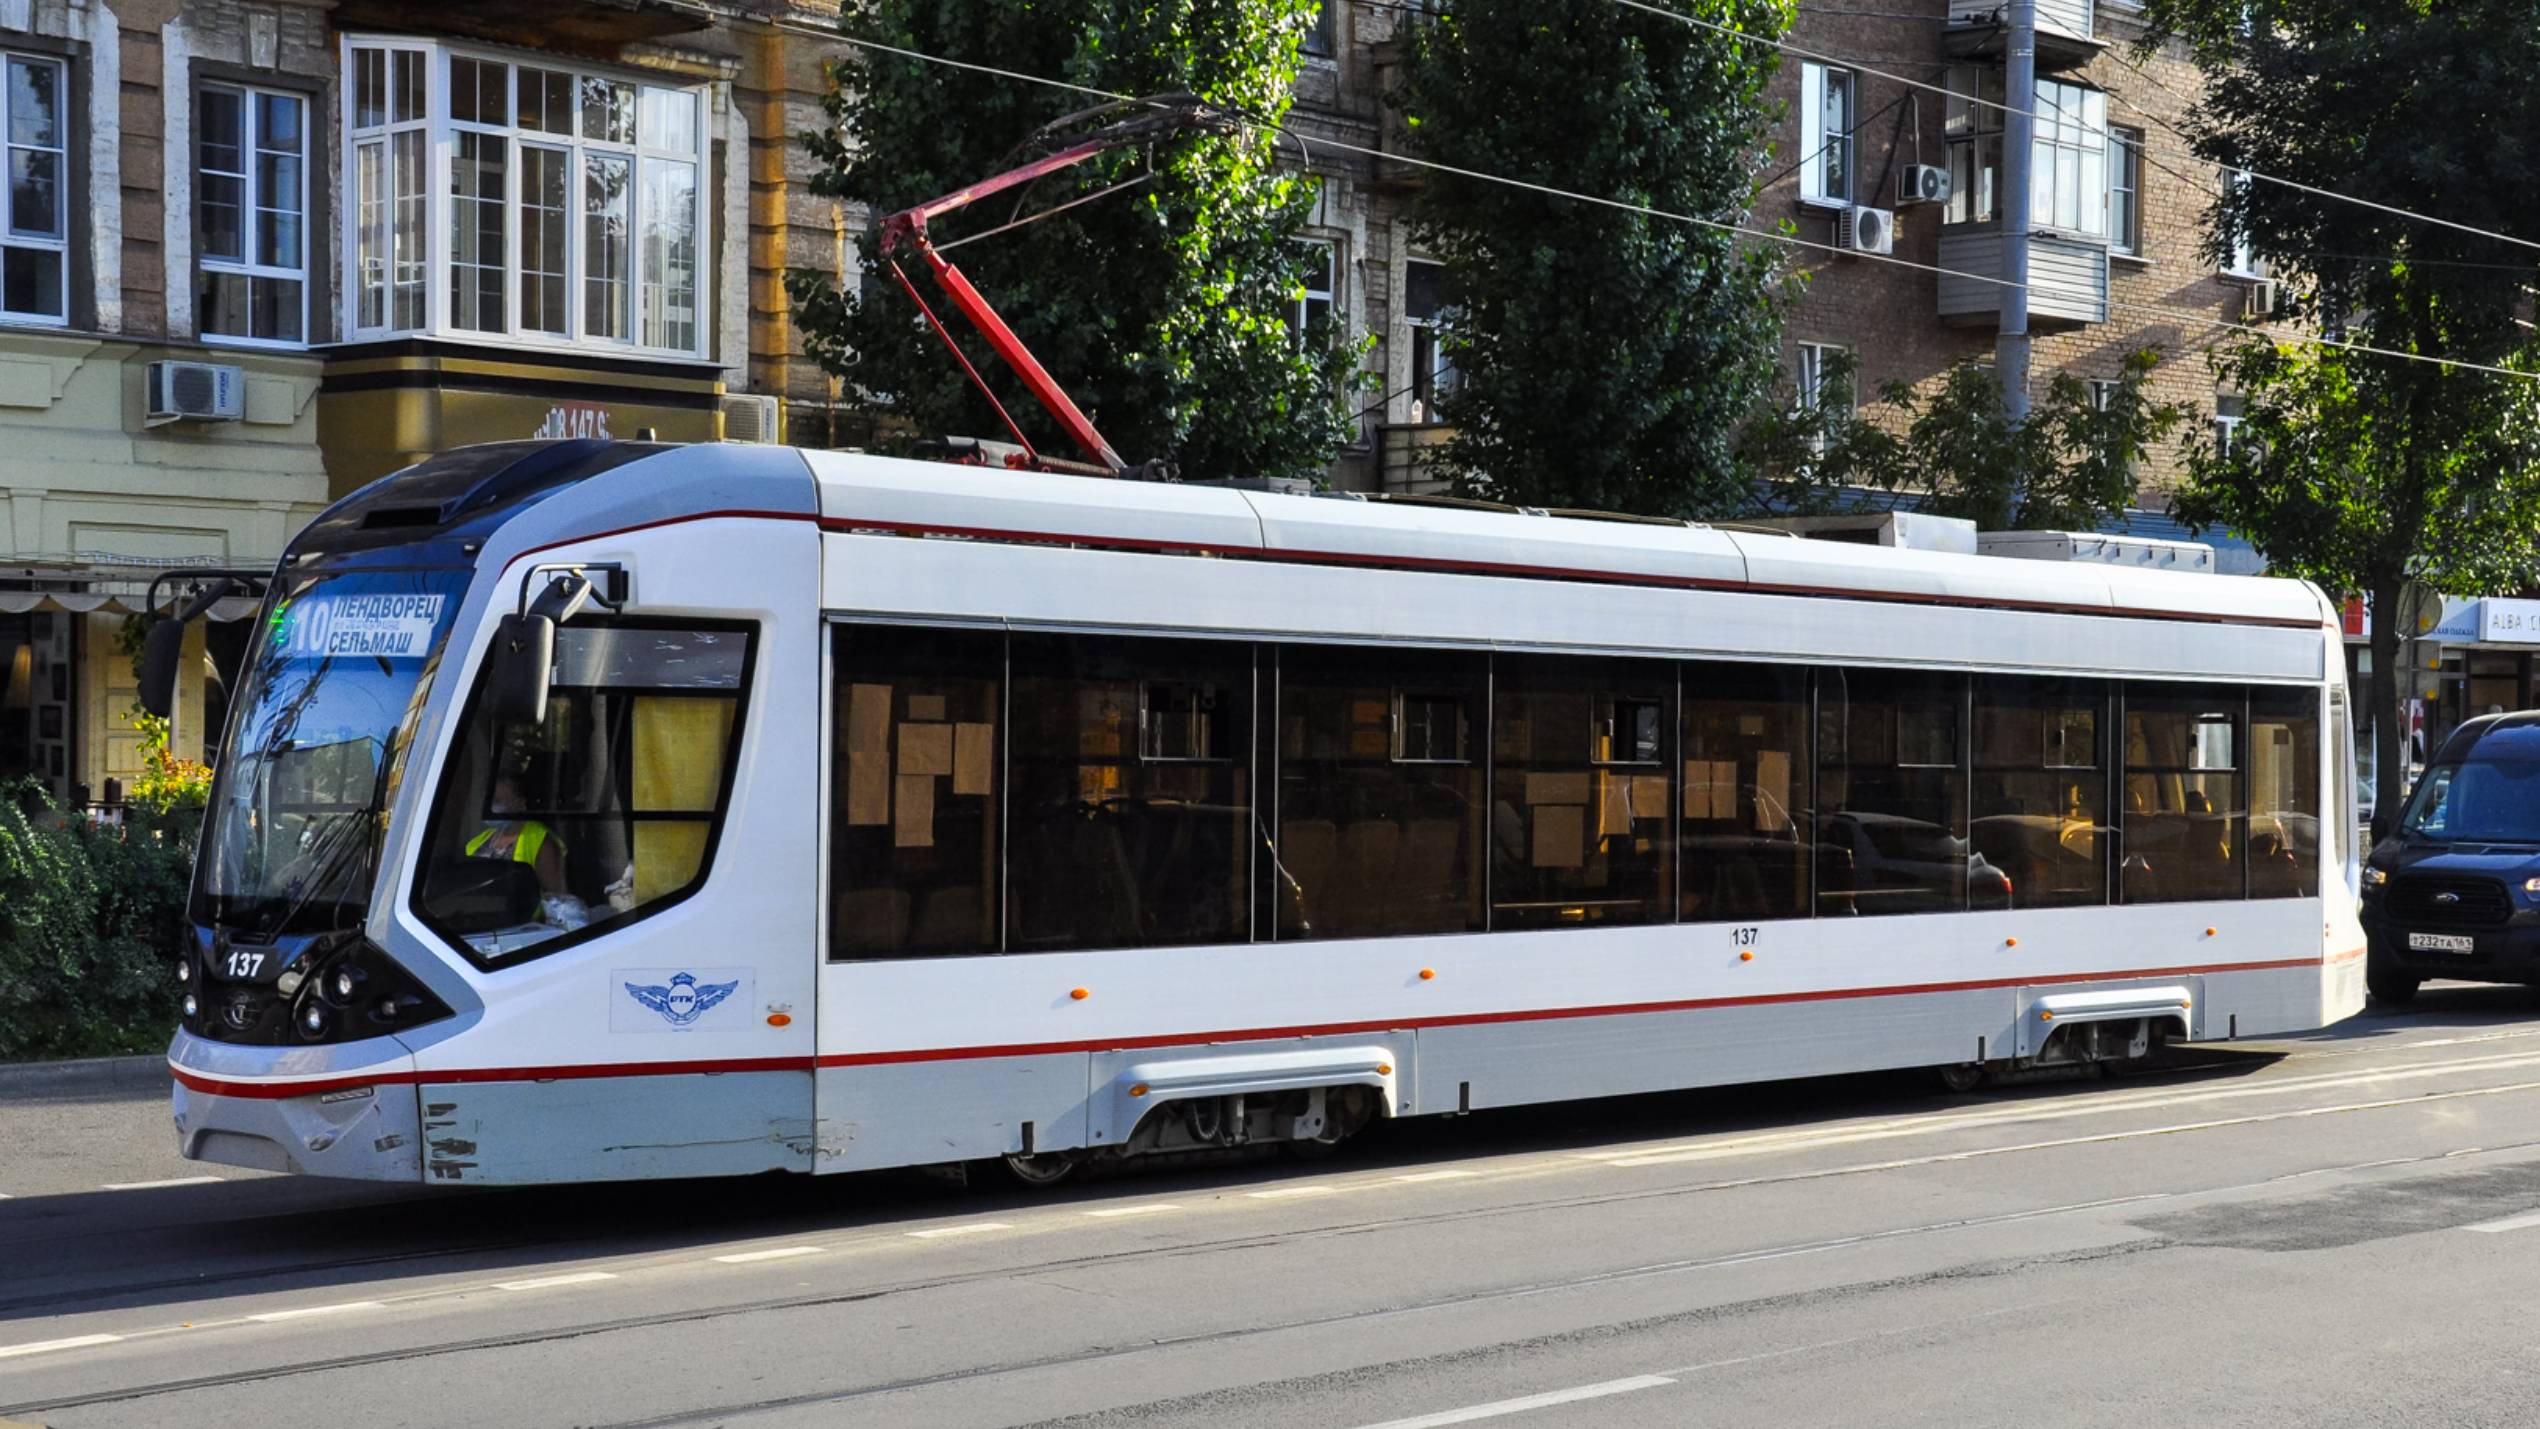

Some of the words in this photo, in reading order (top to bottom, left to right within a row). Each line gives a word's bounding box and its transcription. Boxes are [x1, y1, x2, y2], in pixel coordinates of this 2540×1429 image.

[334, 597, 439, 624] ЛЕНДВОРЕЦ
[328, 632, 414, 654] СЕЛЬМАШ
[1732, 928, 1759, 945] 137
[228, 952, 265, 977] 137
